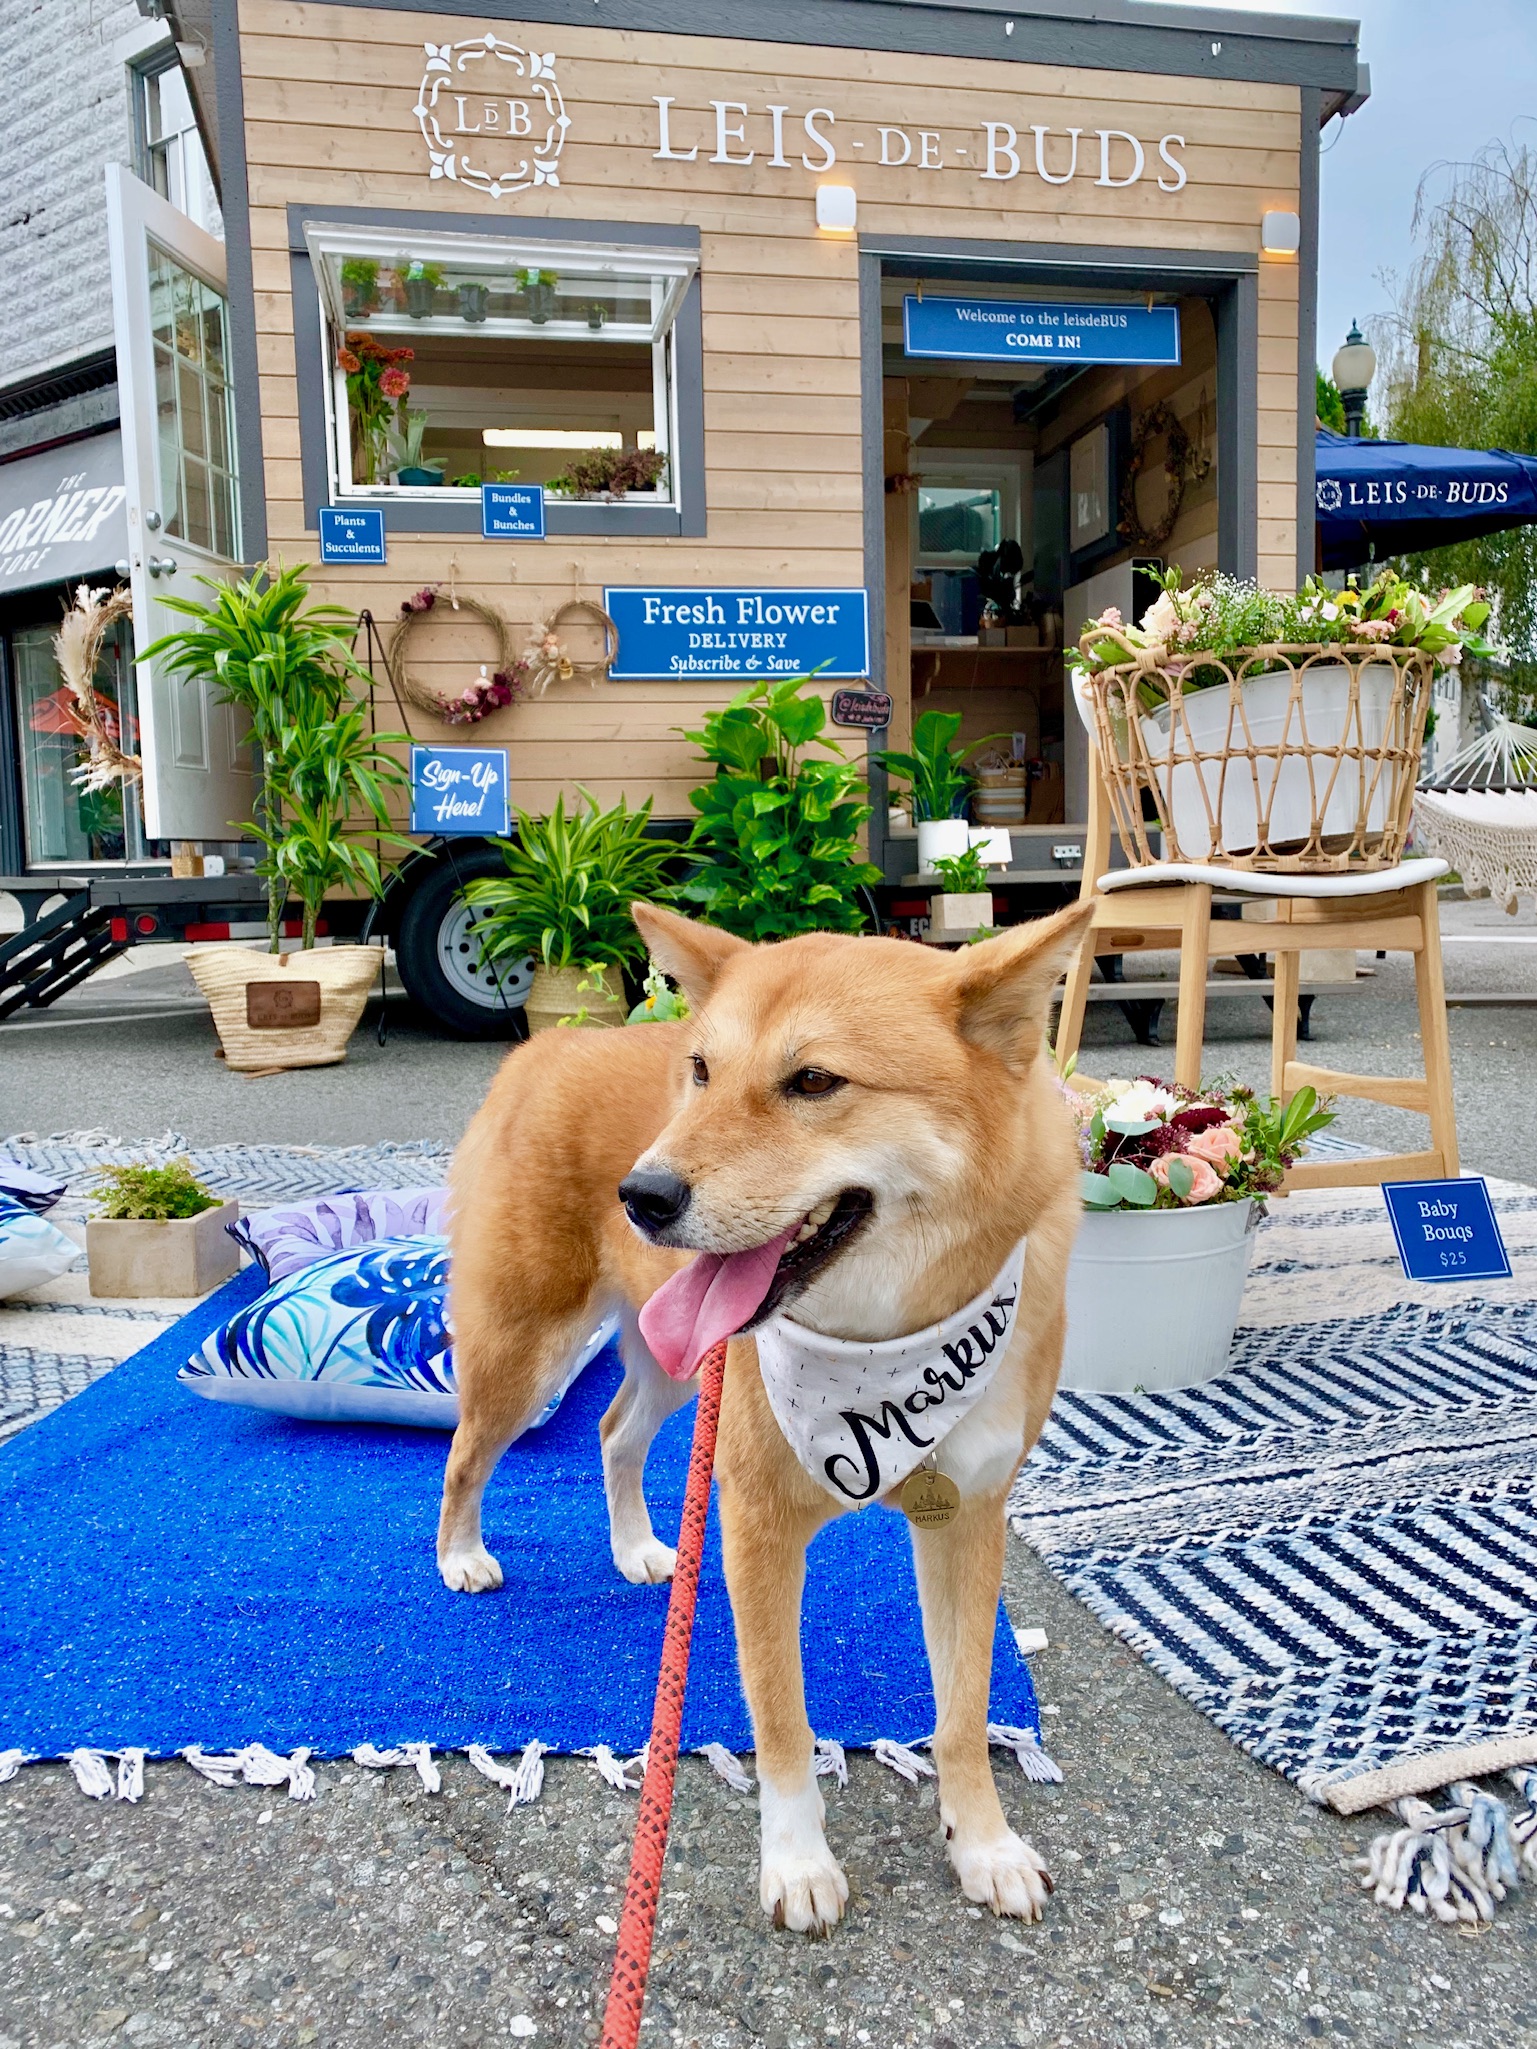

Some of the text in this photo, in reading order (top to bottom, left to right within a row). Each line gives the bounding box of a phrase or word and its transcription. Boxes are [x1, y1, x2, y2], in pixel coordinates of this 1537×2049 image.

[956, 307, 1127, 328] Welcome to the leisdeBUS
[1006, 333, 1081, 349] COME IN!
[56, 472, 87, 493] THE
[491, 492, 531, 505] Bundles
[508, 507, 518, 516] &
[334, 515, 366, 527] Plants
[493, 519, 535, 531] Bunches
[345, 529, 356, 540] &
[325, 542, 381, 554] Succulents
[642, 596, 841, 625] Fresh Flower
[688, 633, 788, 649] DELIVERY
[669, 655, 801, 672] Subscribe & Save
[420, 760, 499, 794] Sign-Up
[432, 792, 486, 822] Here!
[1417, 1199, 1458, 1219] Baby
[1422, 1224, 1474, 1242] Bouqs
[1440, 1251, 1467, 1268] $25
[824, 1282, 1017, 1500] Markus
[915, 1512, 950, 1523] MARKUS
